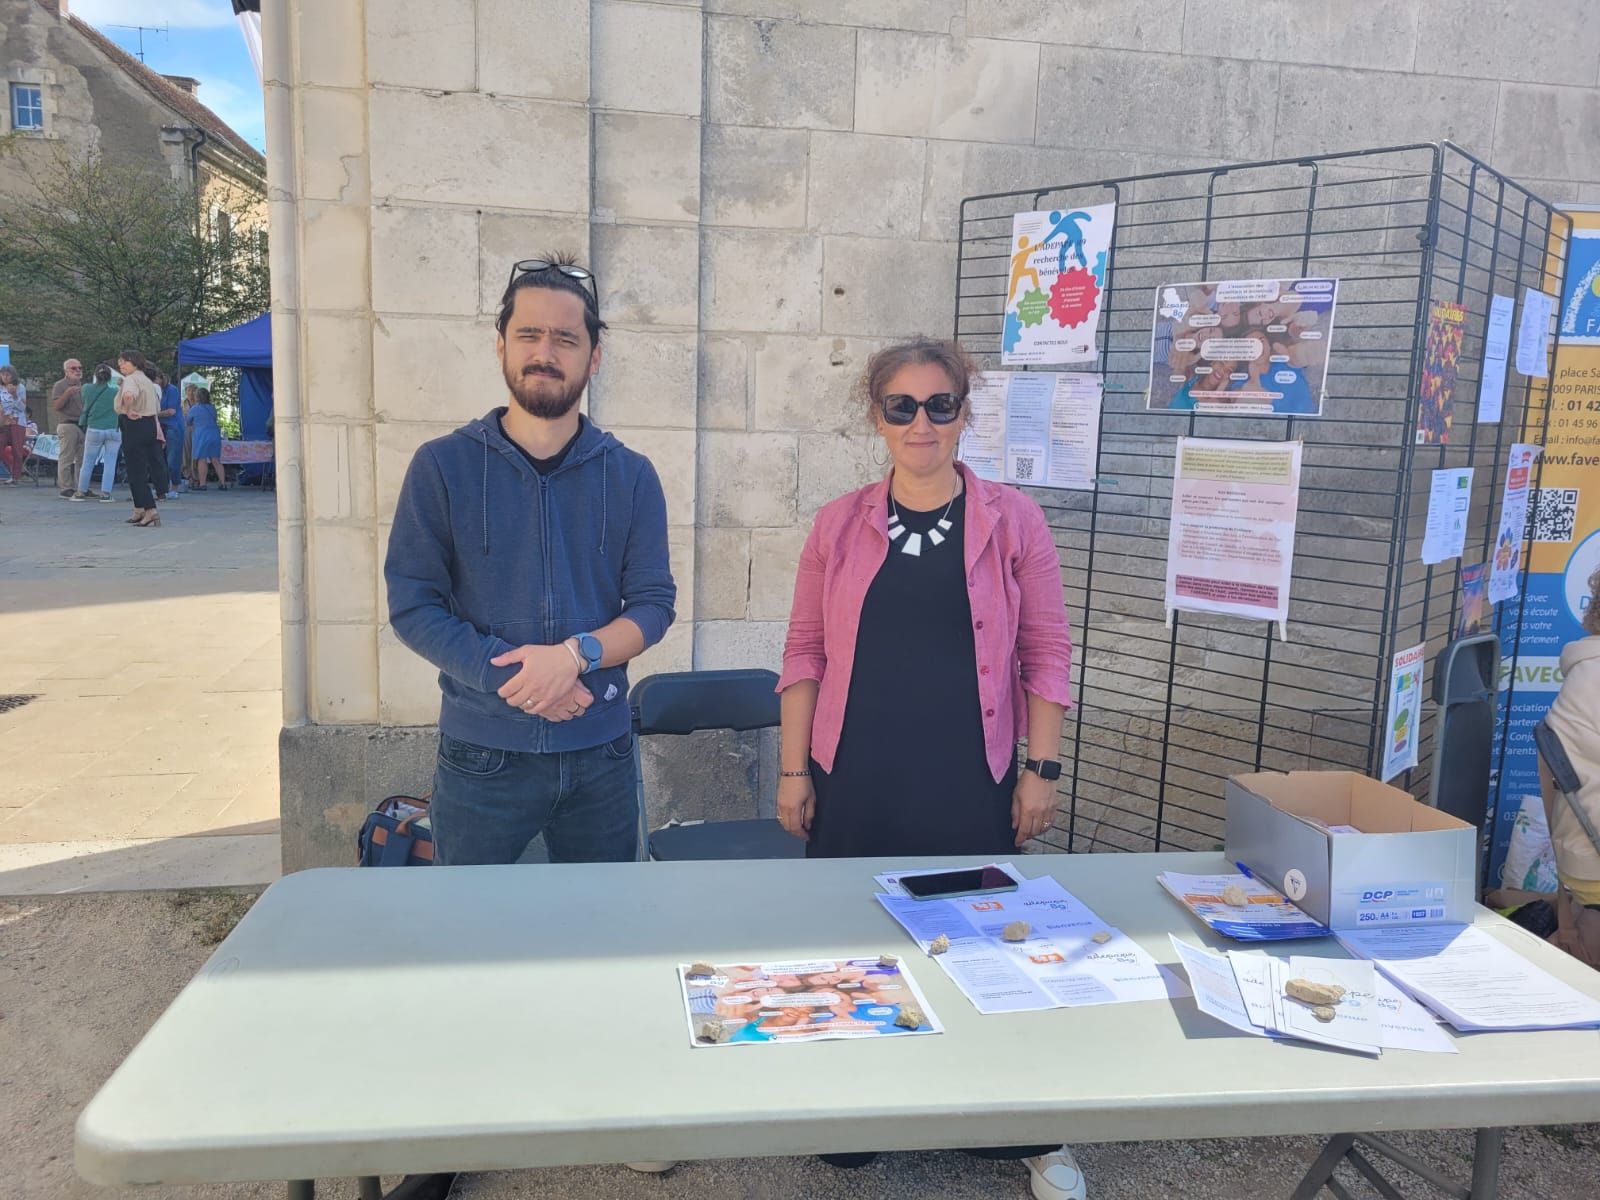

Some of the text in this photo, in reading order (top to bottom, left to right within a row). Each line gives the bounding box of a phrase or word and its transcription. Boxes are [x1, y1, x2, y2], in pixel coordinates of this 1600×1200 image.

[1033, 254, 1068, 265] recherche
[1560, 366, 1588, 379] place
[1541, 383, 1573, 395] 7009
[1567, 399, 1583, 412] 01
[1558, 418, 1570, 429] 01
[1571, 418, 1584, 430] 45
[1586, 418, 1599, 429] 96
[1533, 434, 1560, 446] Eail
[1508, 607, 1559, 617] vos écoute
[1530, 621, 1553, 631] votre
[1505, 634, 1560, 645] déartement
[1362, 890, 1393, 900] DCP
